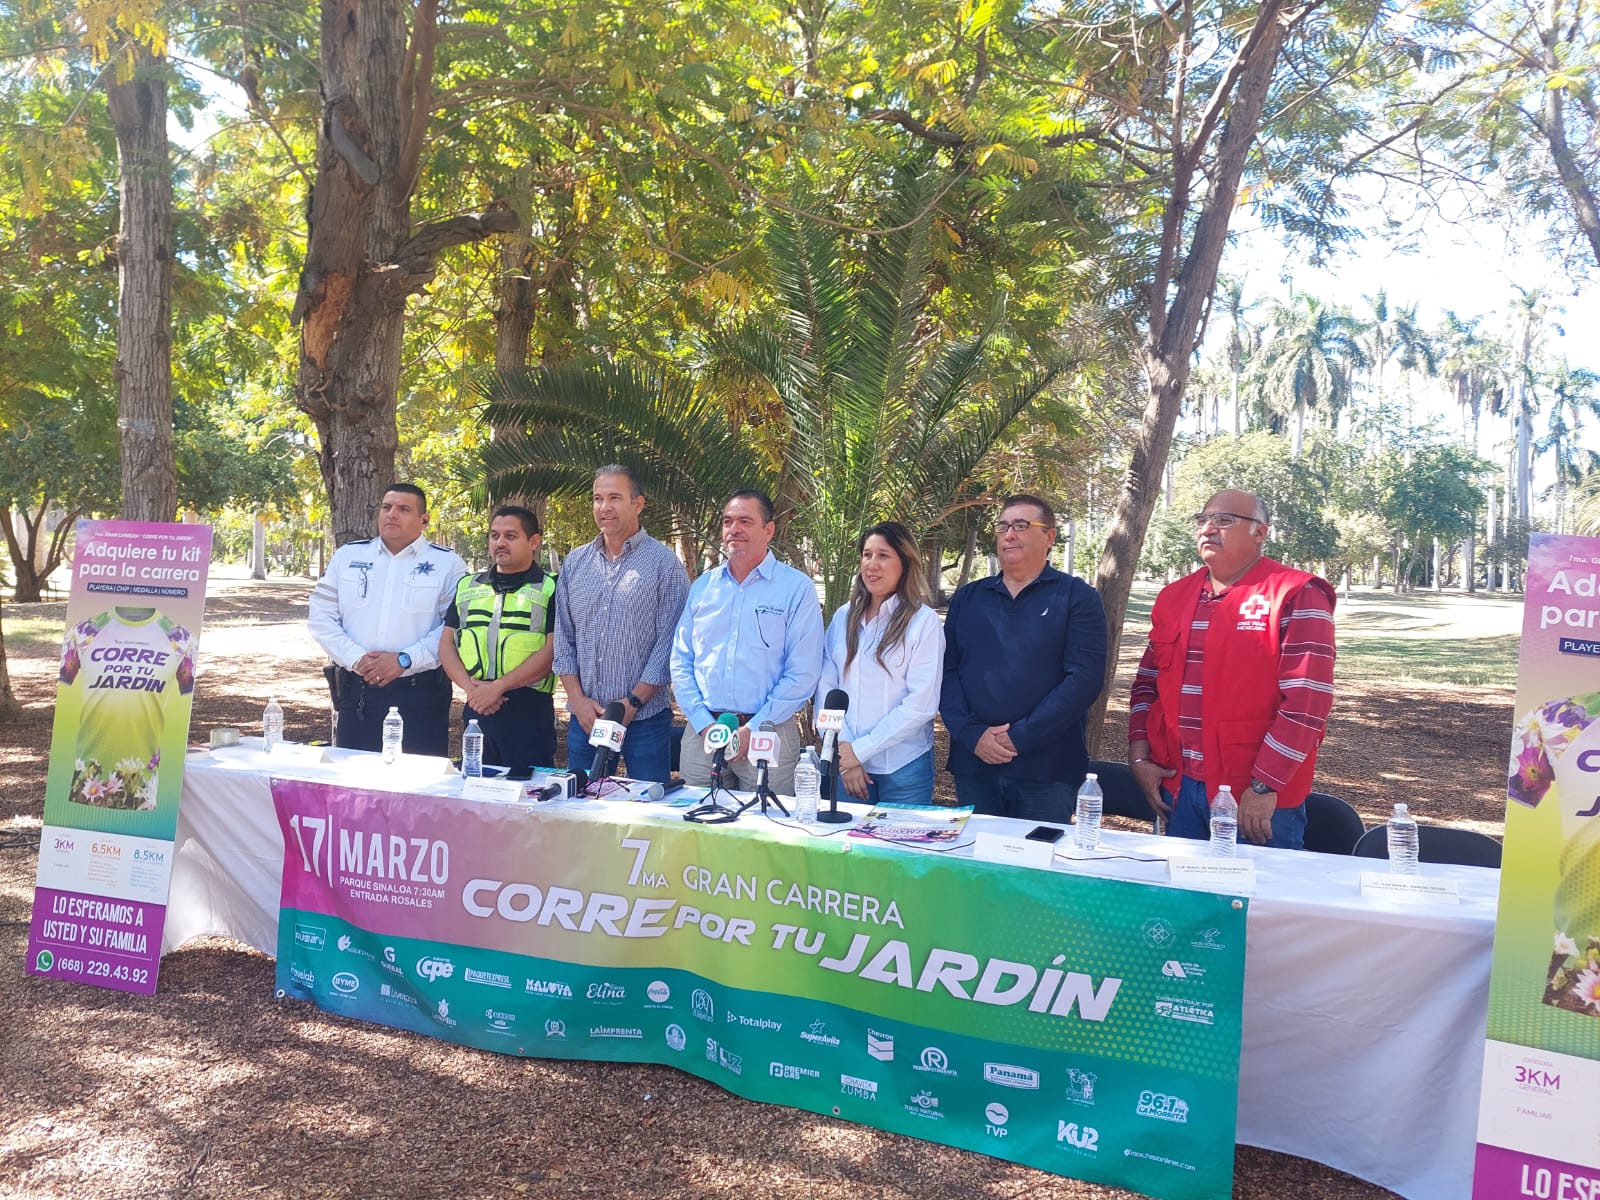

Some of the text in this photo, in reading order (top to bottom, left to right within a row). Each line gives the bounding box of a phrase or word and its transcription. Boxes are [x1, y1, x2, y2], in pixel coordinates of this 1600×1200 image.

[84, 542, 201, 562] Adquiere tu kit
[79, 562, 200, 581] para la carrera
[89, 583, 114, 592] PLAYERA
[133, 586, 157, 595] MEDALLA
[1547, 571, 1600, 597] Ad
[91, 648, 170, 666] CORRE
[104, 665, 132, 673] POR
[828, 714, 844, 722] TVP
[54, 838, 74, 851] 3KM
[91, 843, 120, 856] 6.5KM
[289, 814, 326, 878] 17
[134, 848, 164, 862] 8.5KM
[339, 828, 449, 885] MARZO
[339, 876, 445, 899] PARQUE SINALOA 7:30AM
[350, 888, 433, 909] ENTRADA ROSALES
[682, 865, 757, 901] GRAN
[765, 879, 905, 929] CARRERA
[52, 896, 144, 927] LO ESPERAMOS A
[43, 919, 147, 954] USTED Y SU FAMILIA
[462, 878, 678, 938] CORRE
[674, 905, 756, 946] POR
[770, 923, 827, 955] TU
[818, 933, 1123, 1022] JARDÍN
[57, 957, 148, 984] (668) 229.43.92
[586, 983, 625, 999] Elina
[739, 1015, 782, 1032] Totalplay
[867, 1028, 894, 1041] Chevron
[784, 1065, 820, 1078] PREMIER
[784, 1071, 800, 1080] GAS
[990, 1066, 1033, 1081] Panamá
[1514, 1065, 1560, 1090] 3KM
[845, 1077, 873, 1090] CHAVITA
[1519, 1084, 1553, 1096] GENERAL
[841, 1084, 877, 1101] ZUMBA
[1141, 1093, 1177, 1112] 96.1
[1149, 1108, 1185, 1120] MORRITA
[1516, 1107, 1553, 1120] FAMILIAR
[985, 1124, 1008, 1138] TVP
[1130, 1151, 1196, 1172] mochisonline.com
[1520, 1164, 1552, 1200] LO
